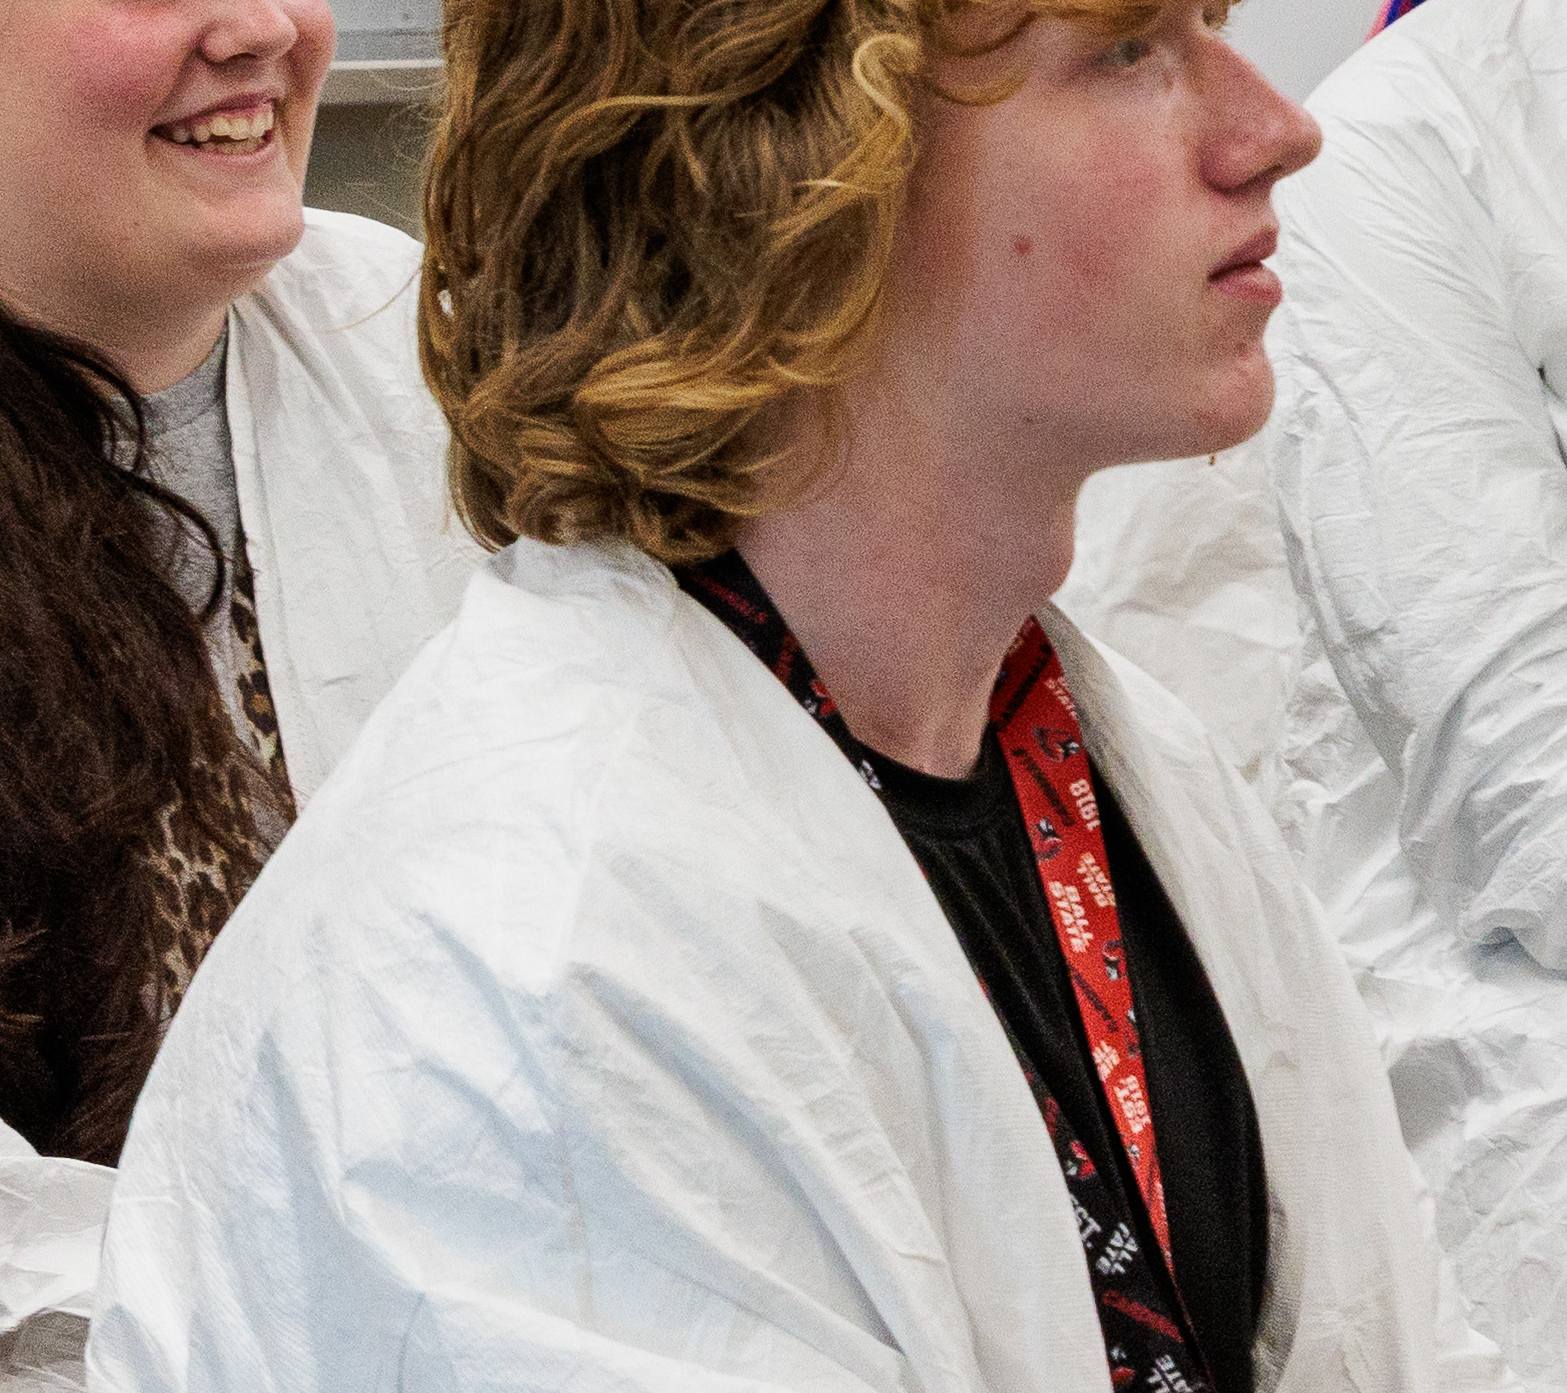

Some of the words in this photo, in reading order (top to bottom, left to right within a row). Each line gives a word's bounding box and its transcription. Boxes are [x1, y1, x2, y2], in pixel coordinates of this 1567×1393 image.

[1069, 778, 1102, 833] 1918
[1048, 880, 1089, 954] STATE
[1064, 885, 1095, 948] BALL
[1069, 1194, 1102, 1248] ST.
[1096, 1222, 1131, 1275] TATE
